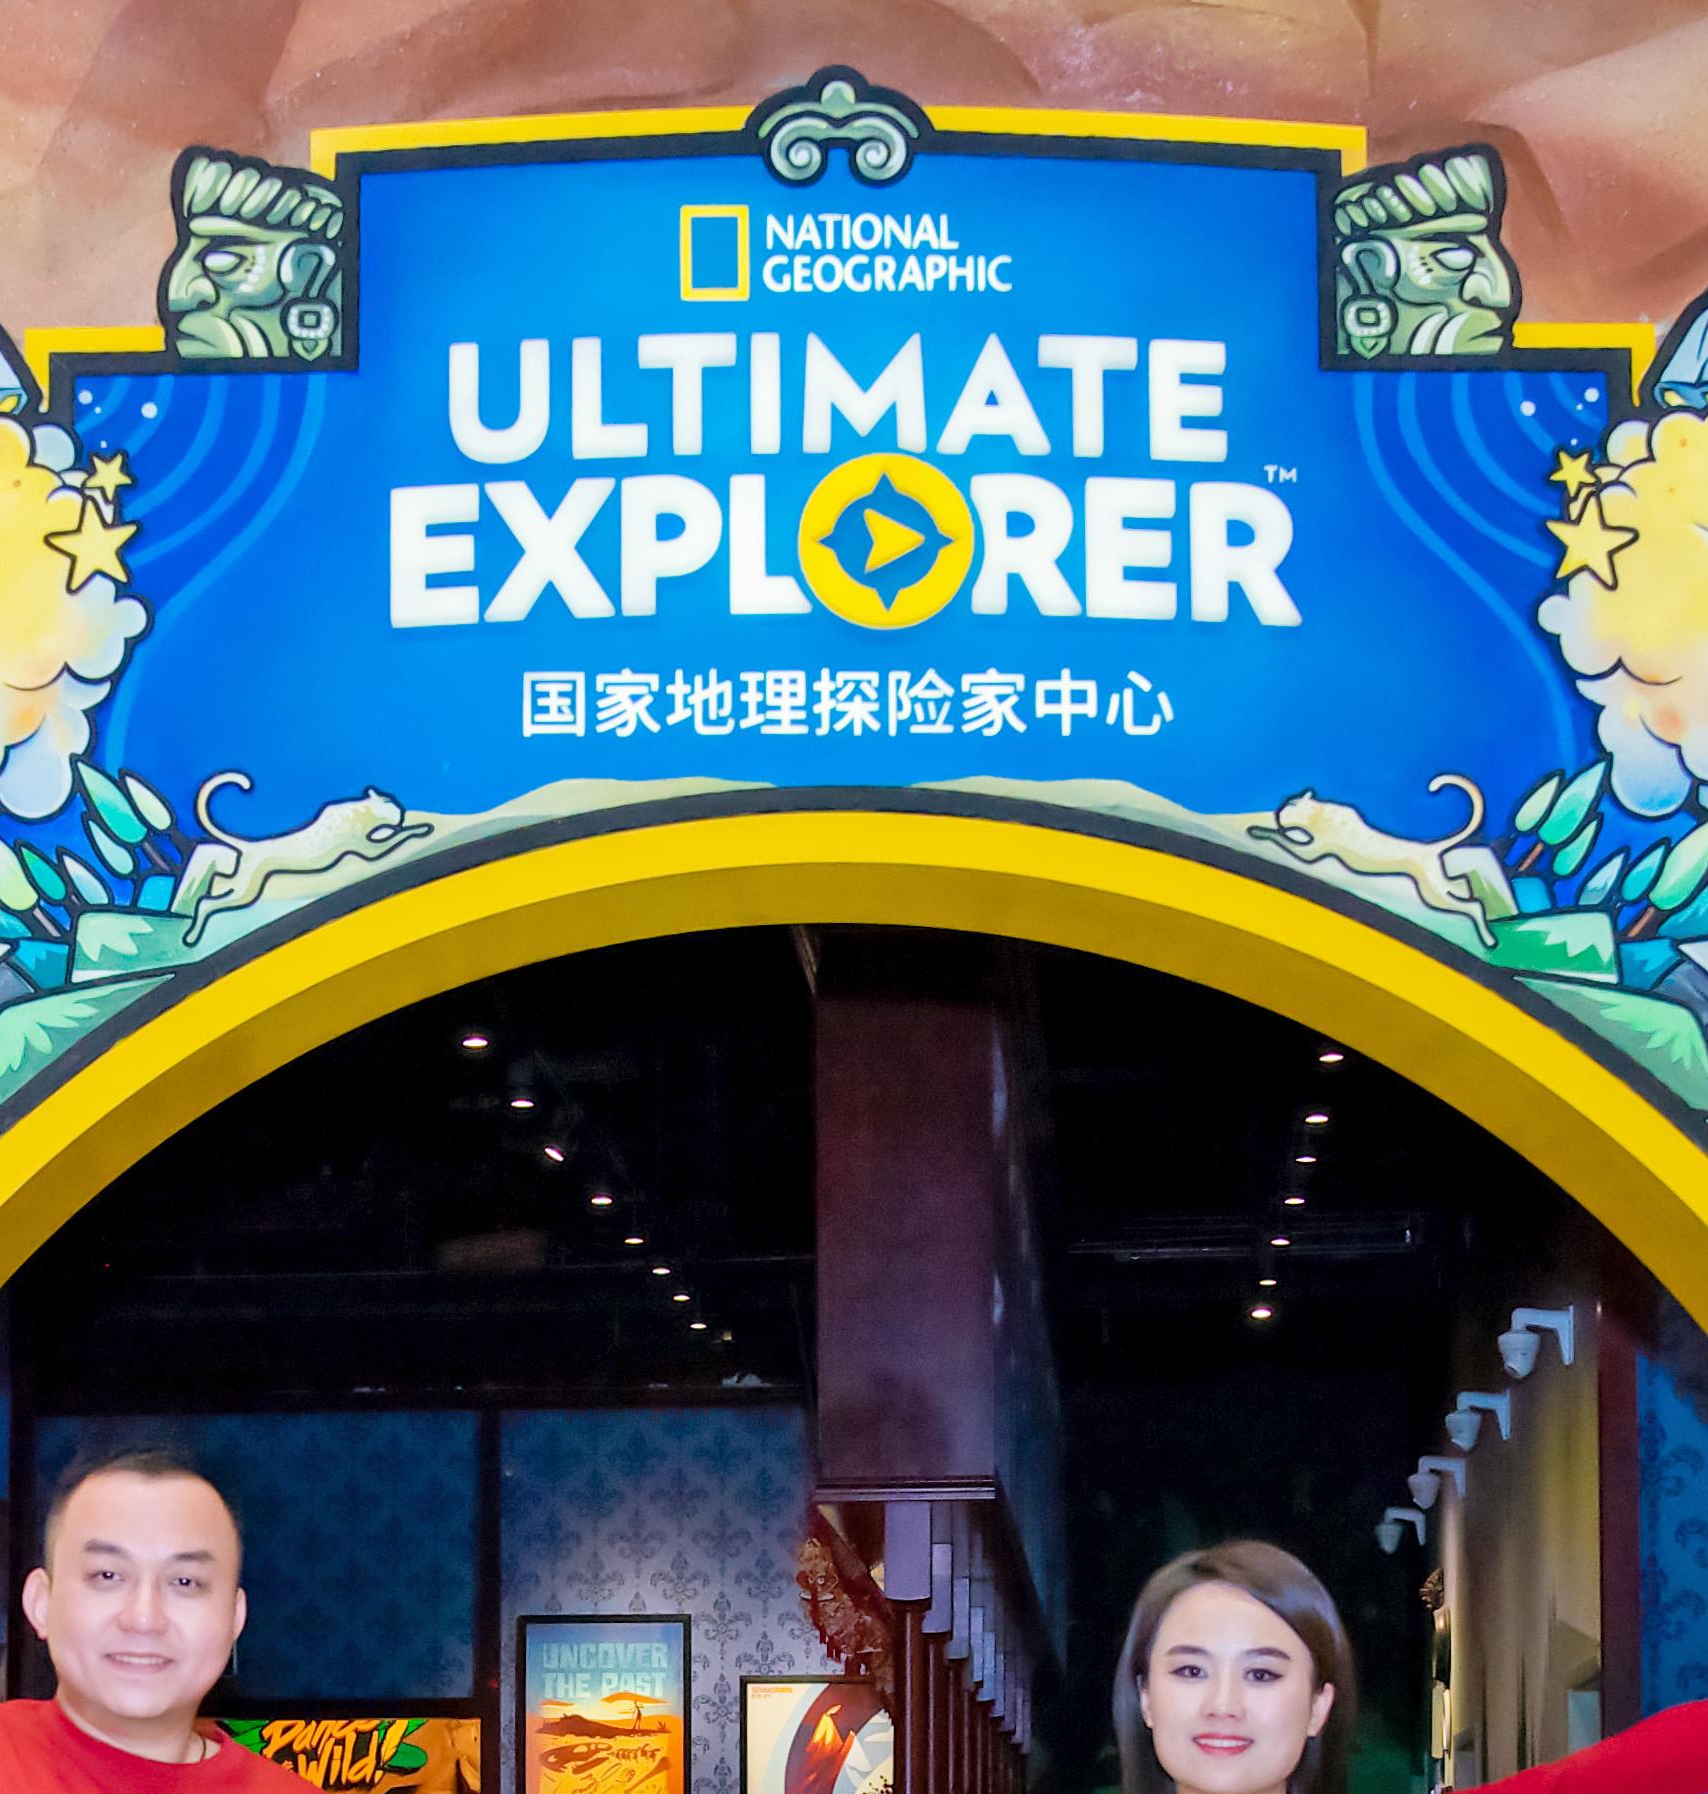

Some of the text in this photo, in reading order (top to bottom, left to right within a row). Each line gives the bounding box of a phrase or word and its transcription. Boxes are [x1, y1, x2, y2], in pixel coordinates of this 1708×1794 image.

[766, 212, 959, 250] NATIONAL
[762, 253, 1012, 292] GEOGRAPHIC
[449, 331, 1228, 463] ULTIMATE
[390, 453, 1301, 629] EXPLORER
[521, 667, 1174, 738] 国家地理探险家中心
[543, 1643, 668, 1669] UNCOVER
[543, 1672, 667, 1698] THE PAST
